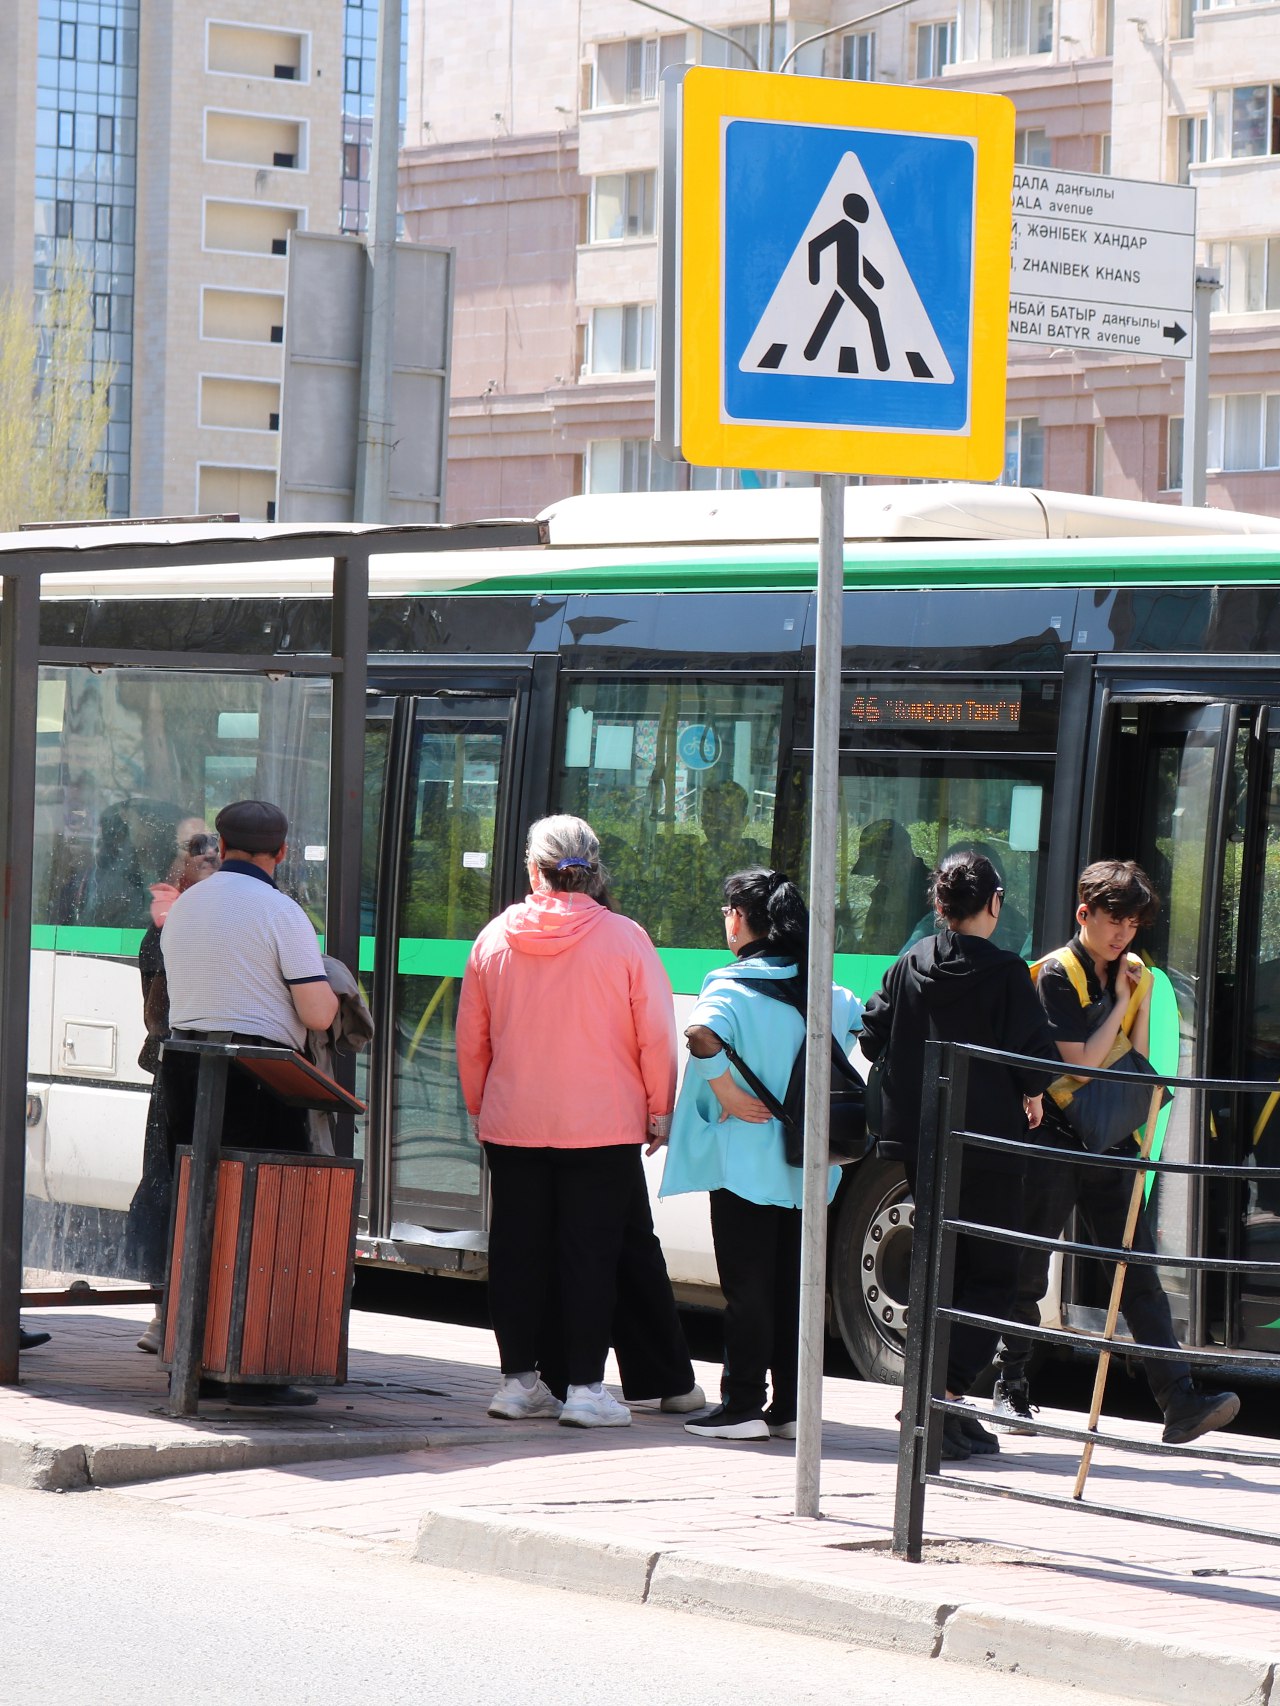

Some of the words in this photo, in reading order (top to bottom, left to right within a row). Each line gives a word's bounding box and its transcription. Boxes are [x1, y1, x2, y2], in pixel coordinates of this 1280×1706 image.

[1055, 183, 1115, 200] даңғылы
[1049, 201, 1094, 216] avenue
[1027, 223, 1088, 243] ЖӘНІБЕК
[1093, 231, 1148, 250] ХАНДАР
[1022, 258, 1090, 278] ZHANIBEK
[1095, 267, 1141, 284] KHANS
[1009, 301, 1045, 317] НБАЙ
[1050, 305, 1096, 321] БАТЫР
[1102, 312, 1161, 329] даңғылы
[1008, 320, 1041, 335] NBAI
[1047, 326, 1090, 340] BATYR
[1097, 331, 1141, 345] avenue
[851, 697, 880, 722] 46
